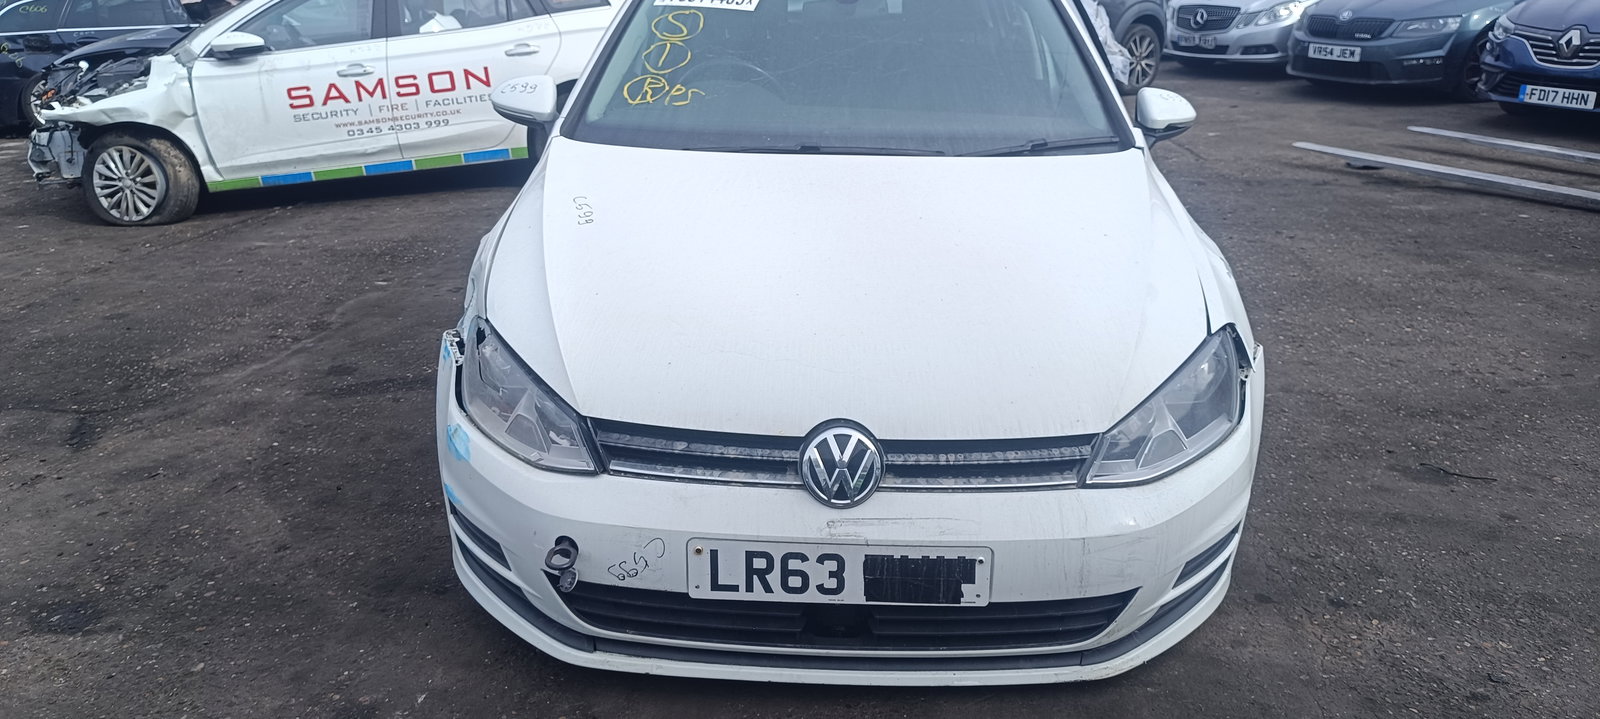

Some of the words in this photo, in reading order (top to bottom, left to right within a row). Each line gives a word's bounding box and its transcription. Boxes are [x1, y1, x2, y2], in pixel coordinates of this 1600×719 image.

[286, 66, 492, 110] SAMSON
[1528, 88, 1559, 103] FD17
[1561, 91, 1590, 106] HHN
[293, 107, 359, 123] SECURITY
[378, 102, 409, 113] FIRE
[347, 126, 383, 137] 0345
[387, 121, 421, 132] 4303
[425, 118, 450, 128] 999
[802, 427, 881, 504] VW
[709, 548, 846, 596] LR63
